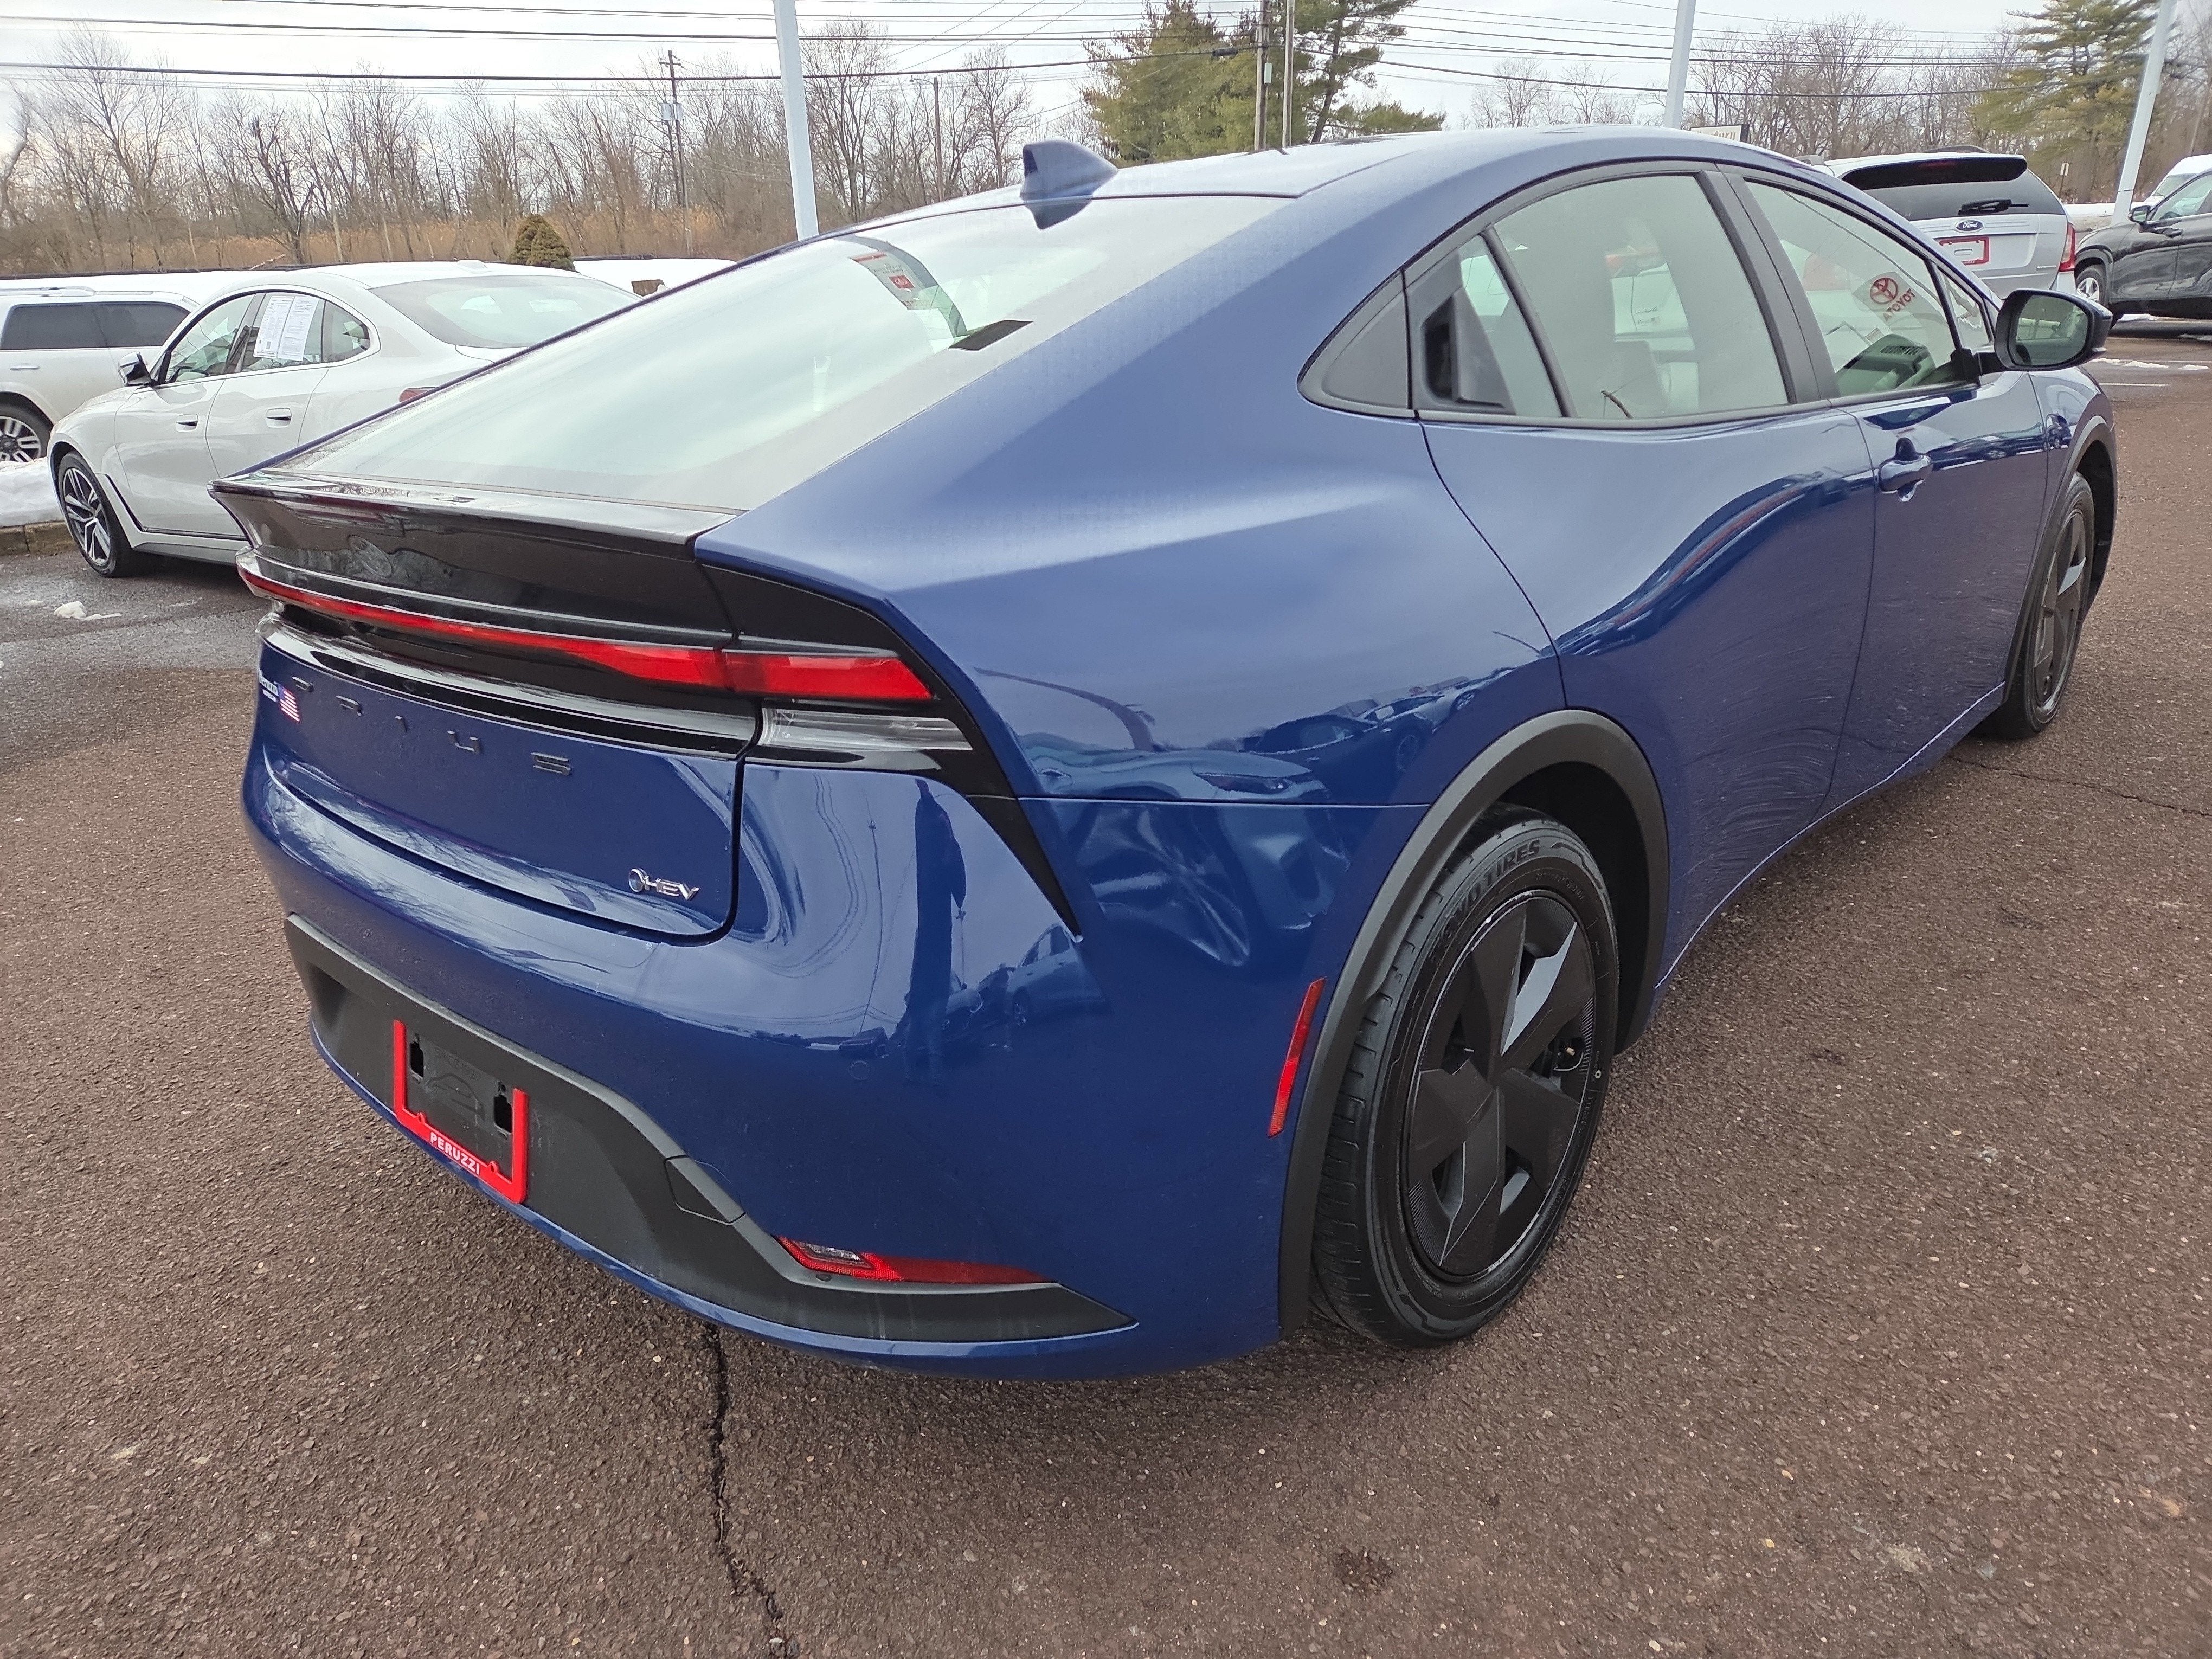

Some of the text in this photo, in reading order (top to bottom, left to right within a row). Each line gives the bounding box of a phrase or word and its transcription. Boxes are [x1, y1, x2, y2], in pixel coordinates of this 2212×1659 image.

[291, 676, 573, 777] PRIUS
[1483, 839, 1541, 888] TIRES
[644, 875, 700, 901] HEV
[430, 1131, 480, 1175] PERUZZI
